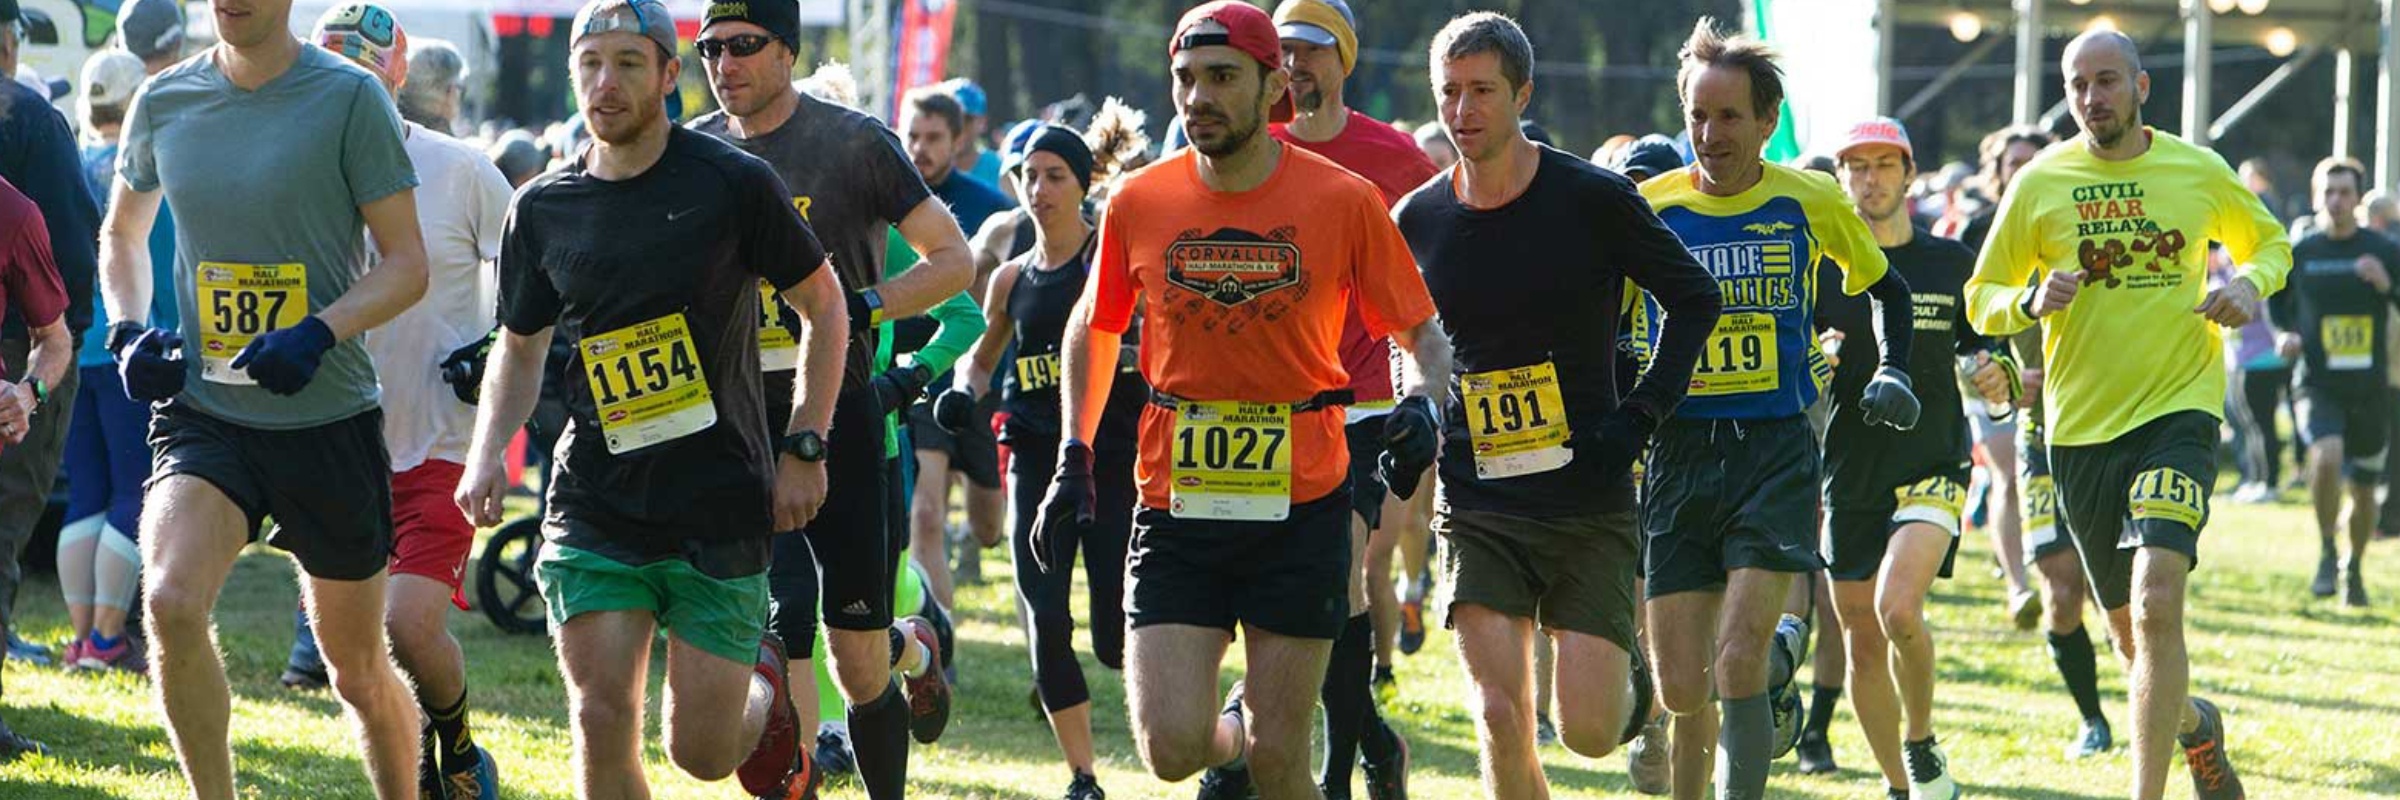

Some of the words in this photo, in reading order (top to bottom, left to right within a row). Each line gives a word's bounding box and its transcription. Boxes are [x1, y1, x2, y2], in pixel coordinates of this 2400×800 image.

[2072, 182, 2144, 202] CIVIL
[2075, 199, 2145, 221] WAR
[2077, 218, 2147, 237] RELAY
[1176, 246, 1289, 262] CORVALLIS
[238, 278, 300, 287] MARATHON
[253, 269, 279, 279] HALF
[213, 289, 287, 334] 587
[636, 324, 661, 338] HALF
[1718, 324, 1771, 333] MARATHON
[624, 327, 683, 351] MARATHON
[1697, 335, 1762, 373] 119
[592, 340, 697, 406] 1154
[1510, 372, 1532, 381] HALF
[1498, 376, 1551, 391] MARATHON
[1222, 415, 1284, 424] MARATHON
[1239, 406, 1264, 415] HALF
[1478, 390, 1548, 435] 191
[1177, 427, 1286, 471] 1027
[2133, 471, 2200, 511] 1151
